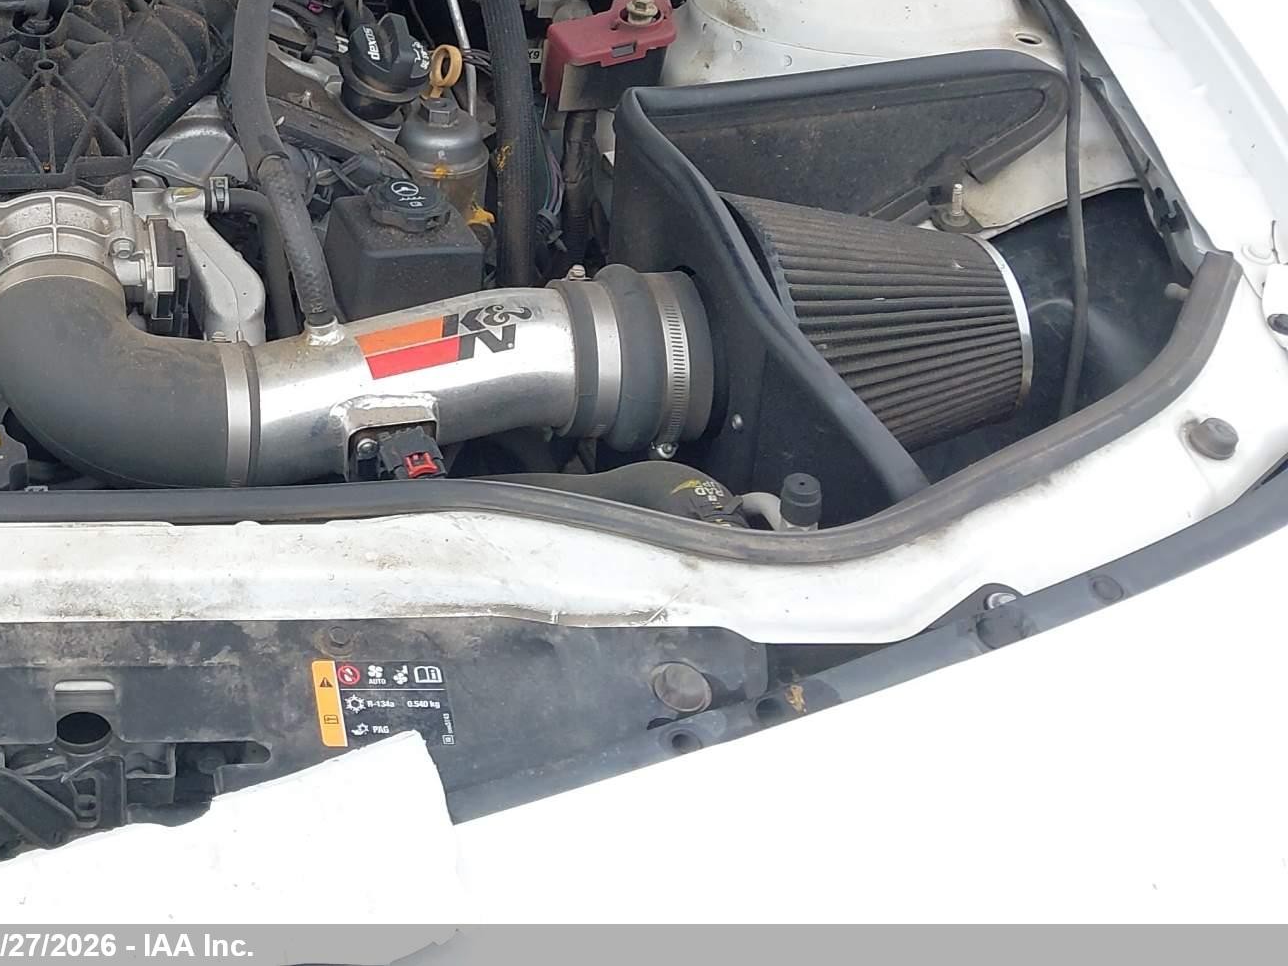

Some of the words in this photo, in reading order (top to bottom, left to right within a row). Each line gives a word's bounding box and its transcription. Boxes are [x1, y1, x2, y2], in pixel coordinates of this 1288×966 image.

[363, 26, 381, 61] dexos
[443, 304, 533, 362] K&N
[368, 678, 387, 686] AUTO
[367, 700, 395, 708] R-134a
[406, 700, 429, 708] 0.540
[429, 700, 441, 710] kg
[372, 725, 390, 734] PAG
